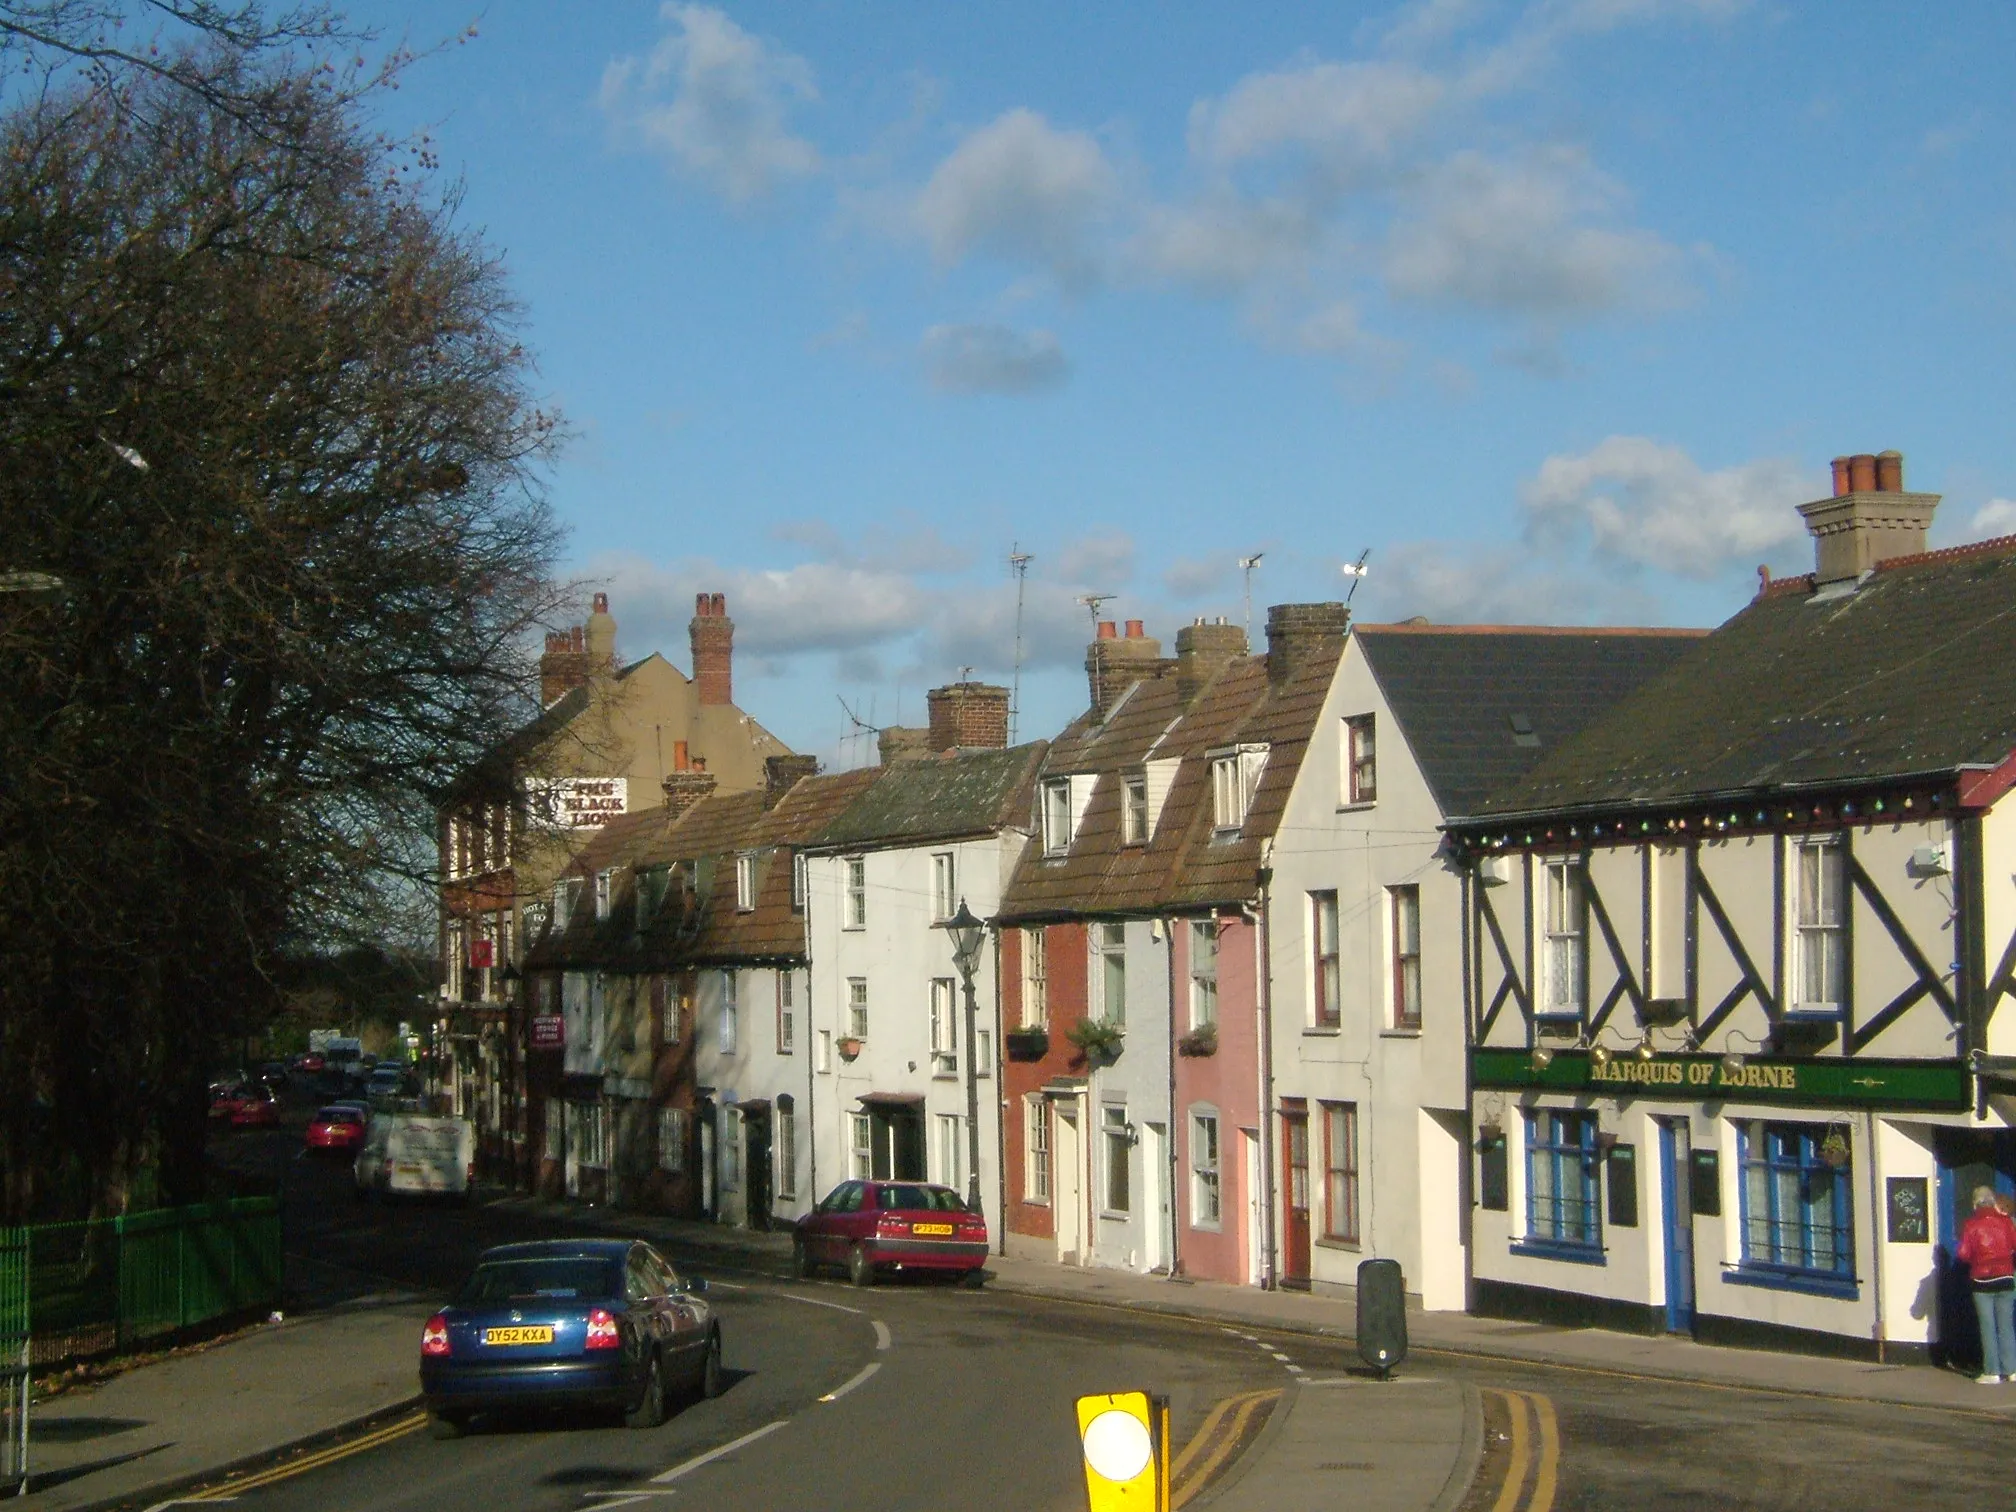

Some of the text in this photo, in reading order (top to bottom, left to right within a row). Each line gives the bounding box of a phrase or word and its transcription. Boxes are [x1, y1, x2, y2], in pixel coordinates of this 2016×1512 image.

[566, 798, 625, 812] BLACK
[1592, 1061, 1796, 1088] MARQUIS OF LORNE
[522, 1329, 546, 1341] KXA
